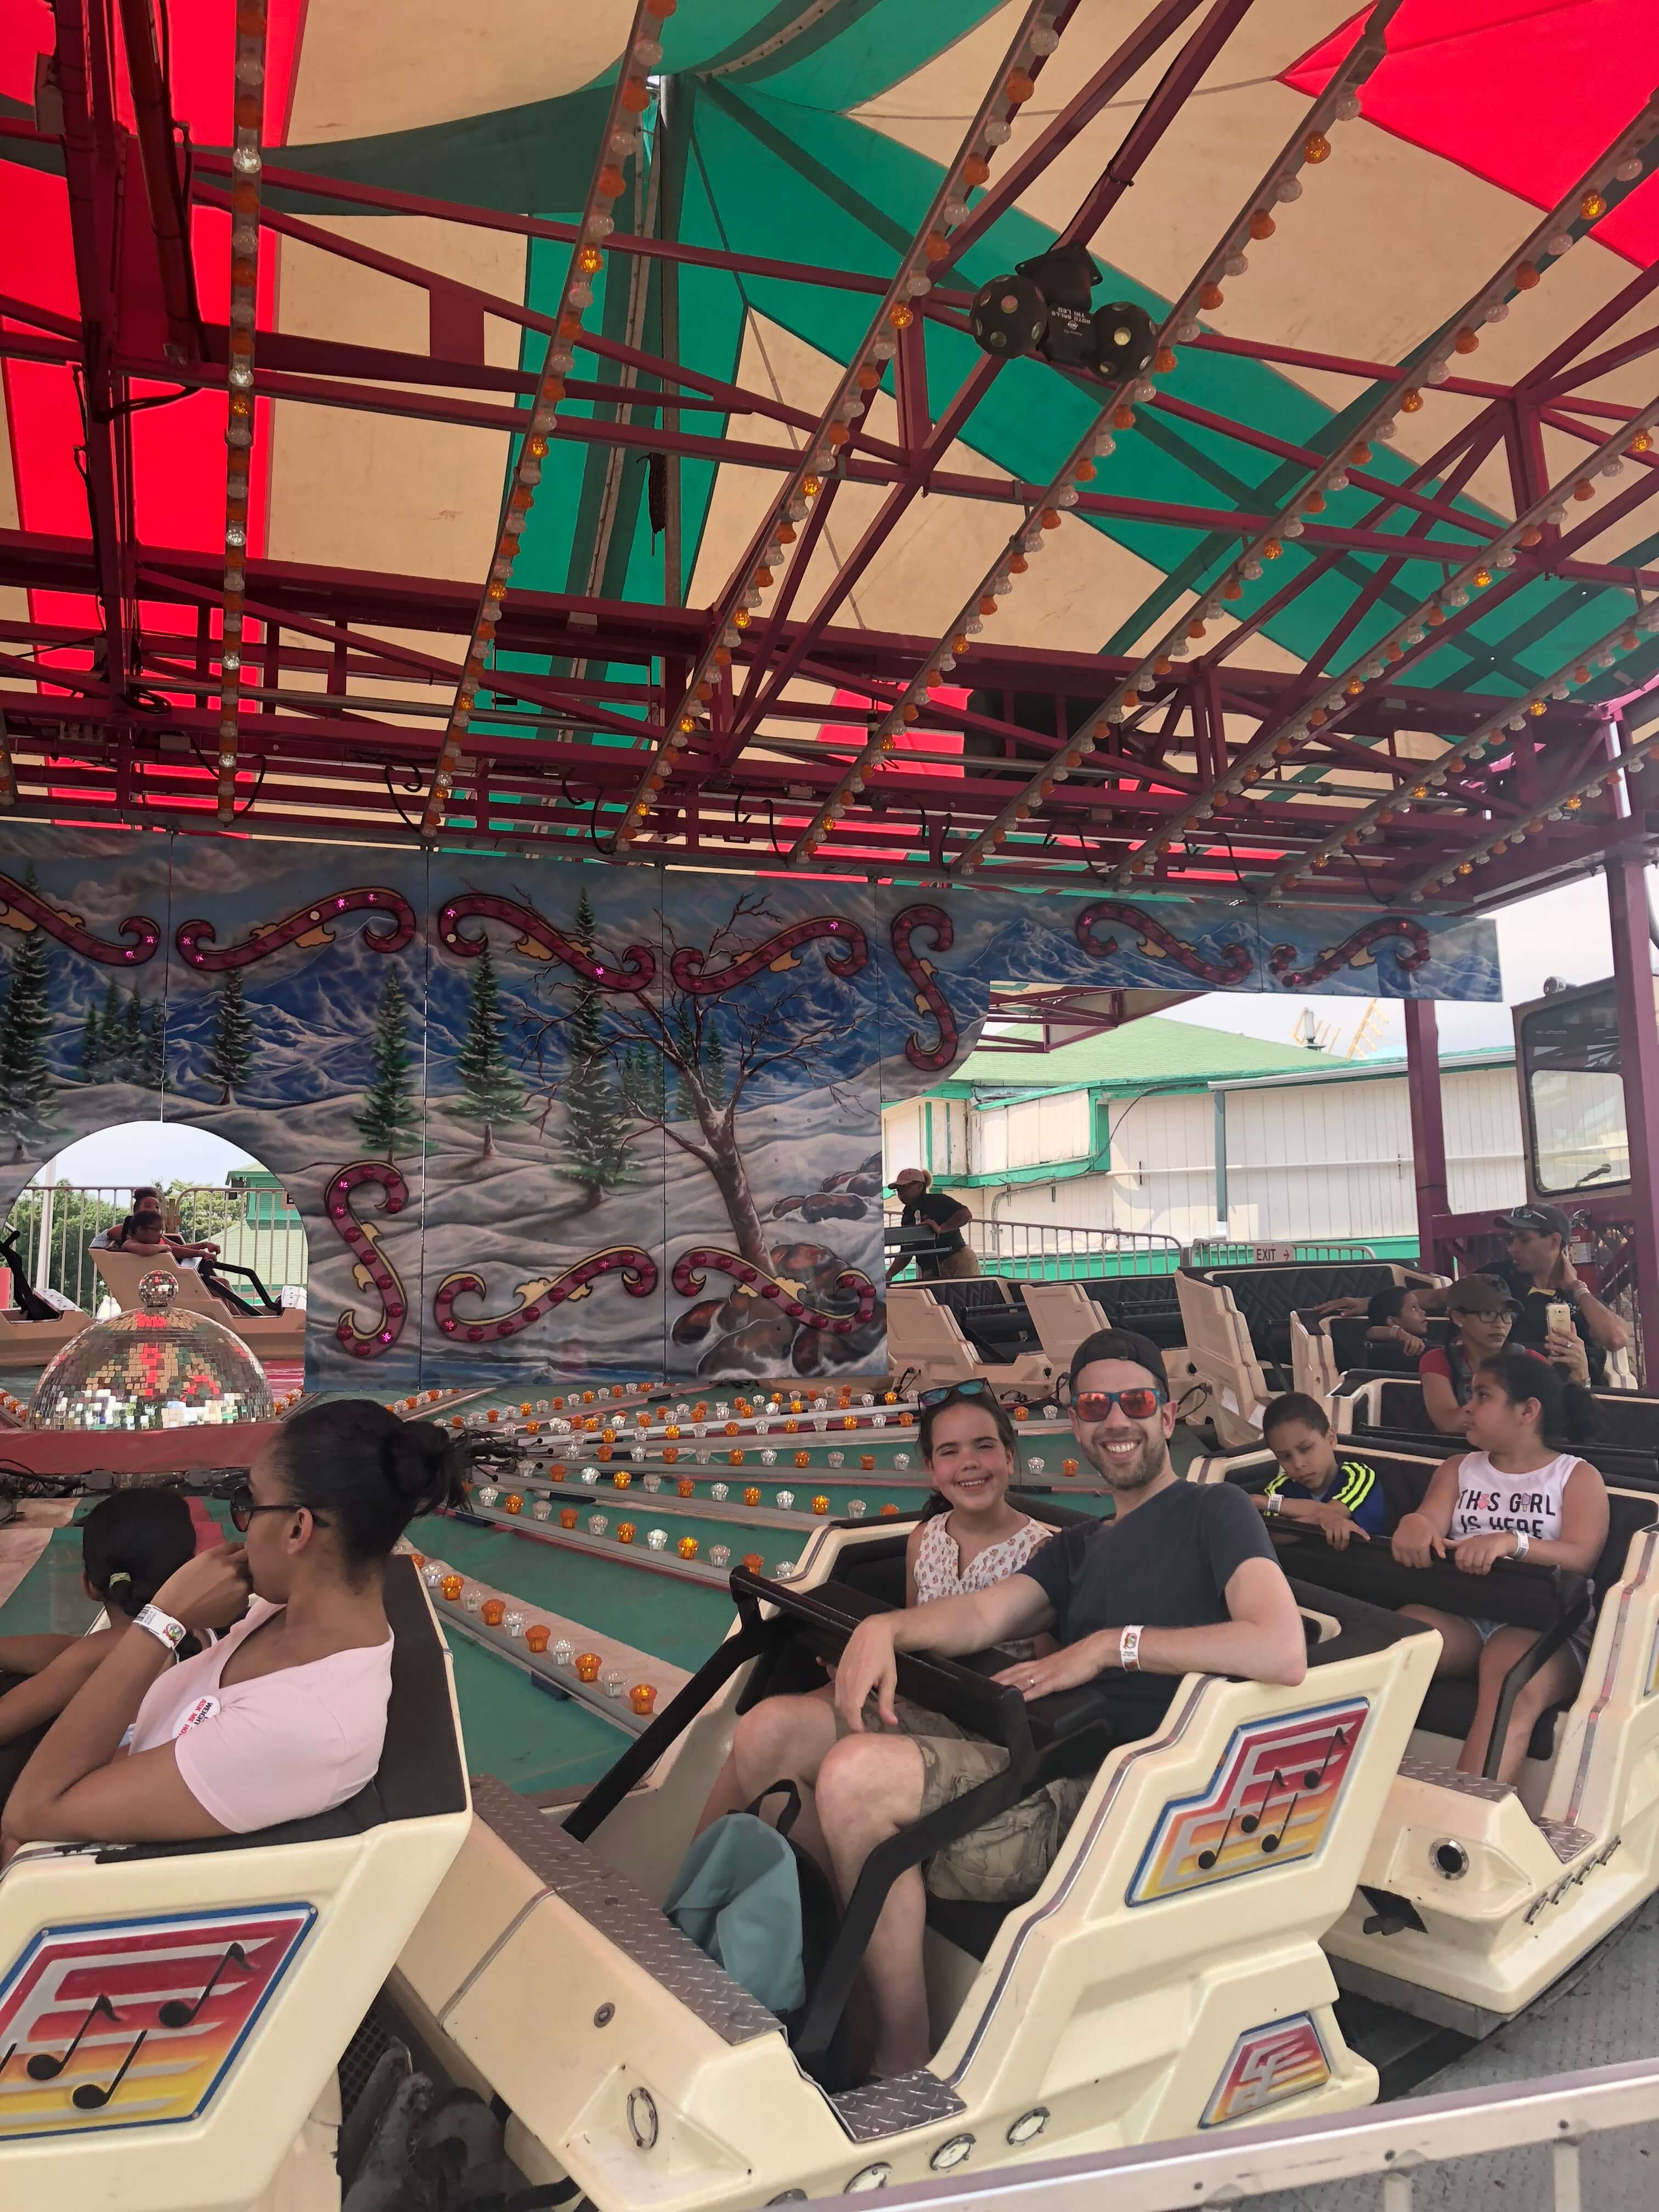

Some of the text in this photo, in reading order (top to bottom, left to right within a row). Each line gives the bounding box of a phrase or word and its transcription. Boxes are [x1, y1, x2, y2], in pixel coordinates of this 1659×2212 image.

[1051, 311, 1071, 319] BALLS
[1058, 307, 1071, 315] LED
[1256, 1248, 1276, 1261] EXIT
[1460, 1515, 1544, 1540] IS HERE
[195, 1699, 206, 1712] ASK
[187, 1712, 198, 1723] ME
